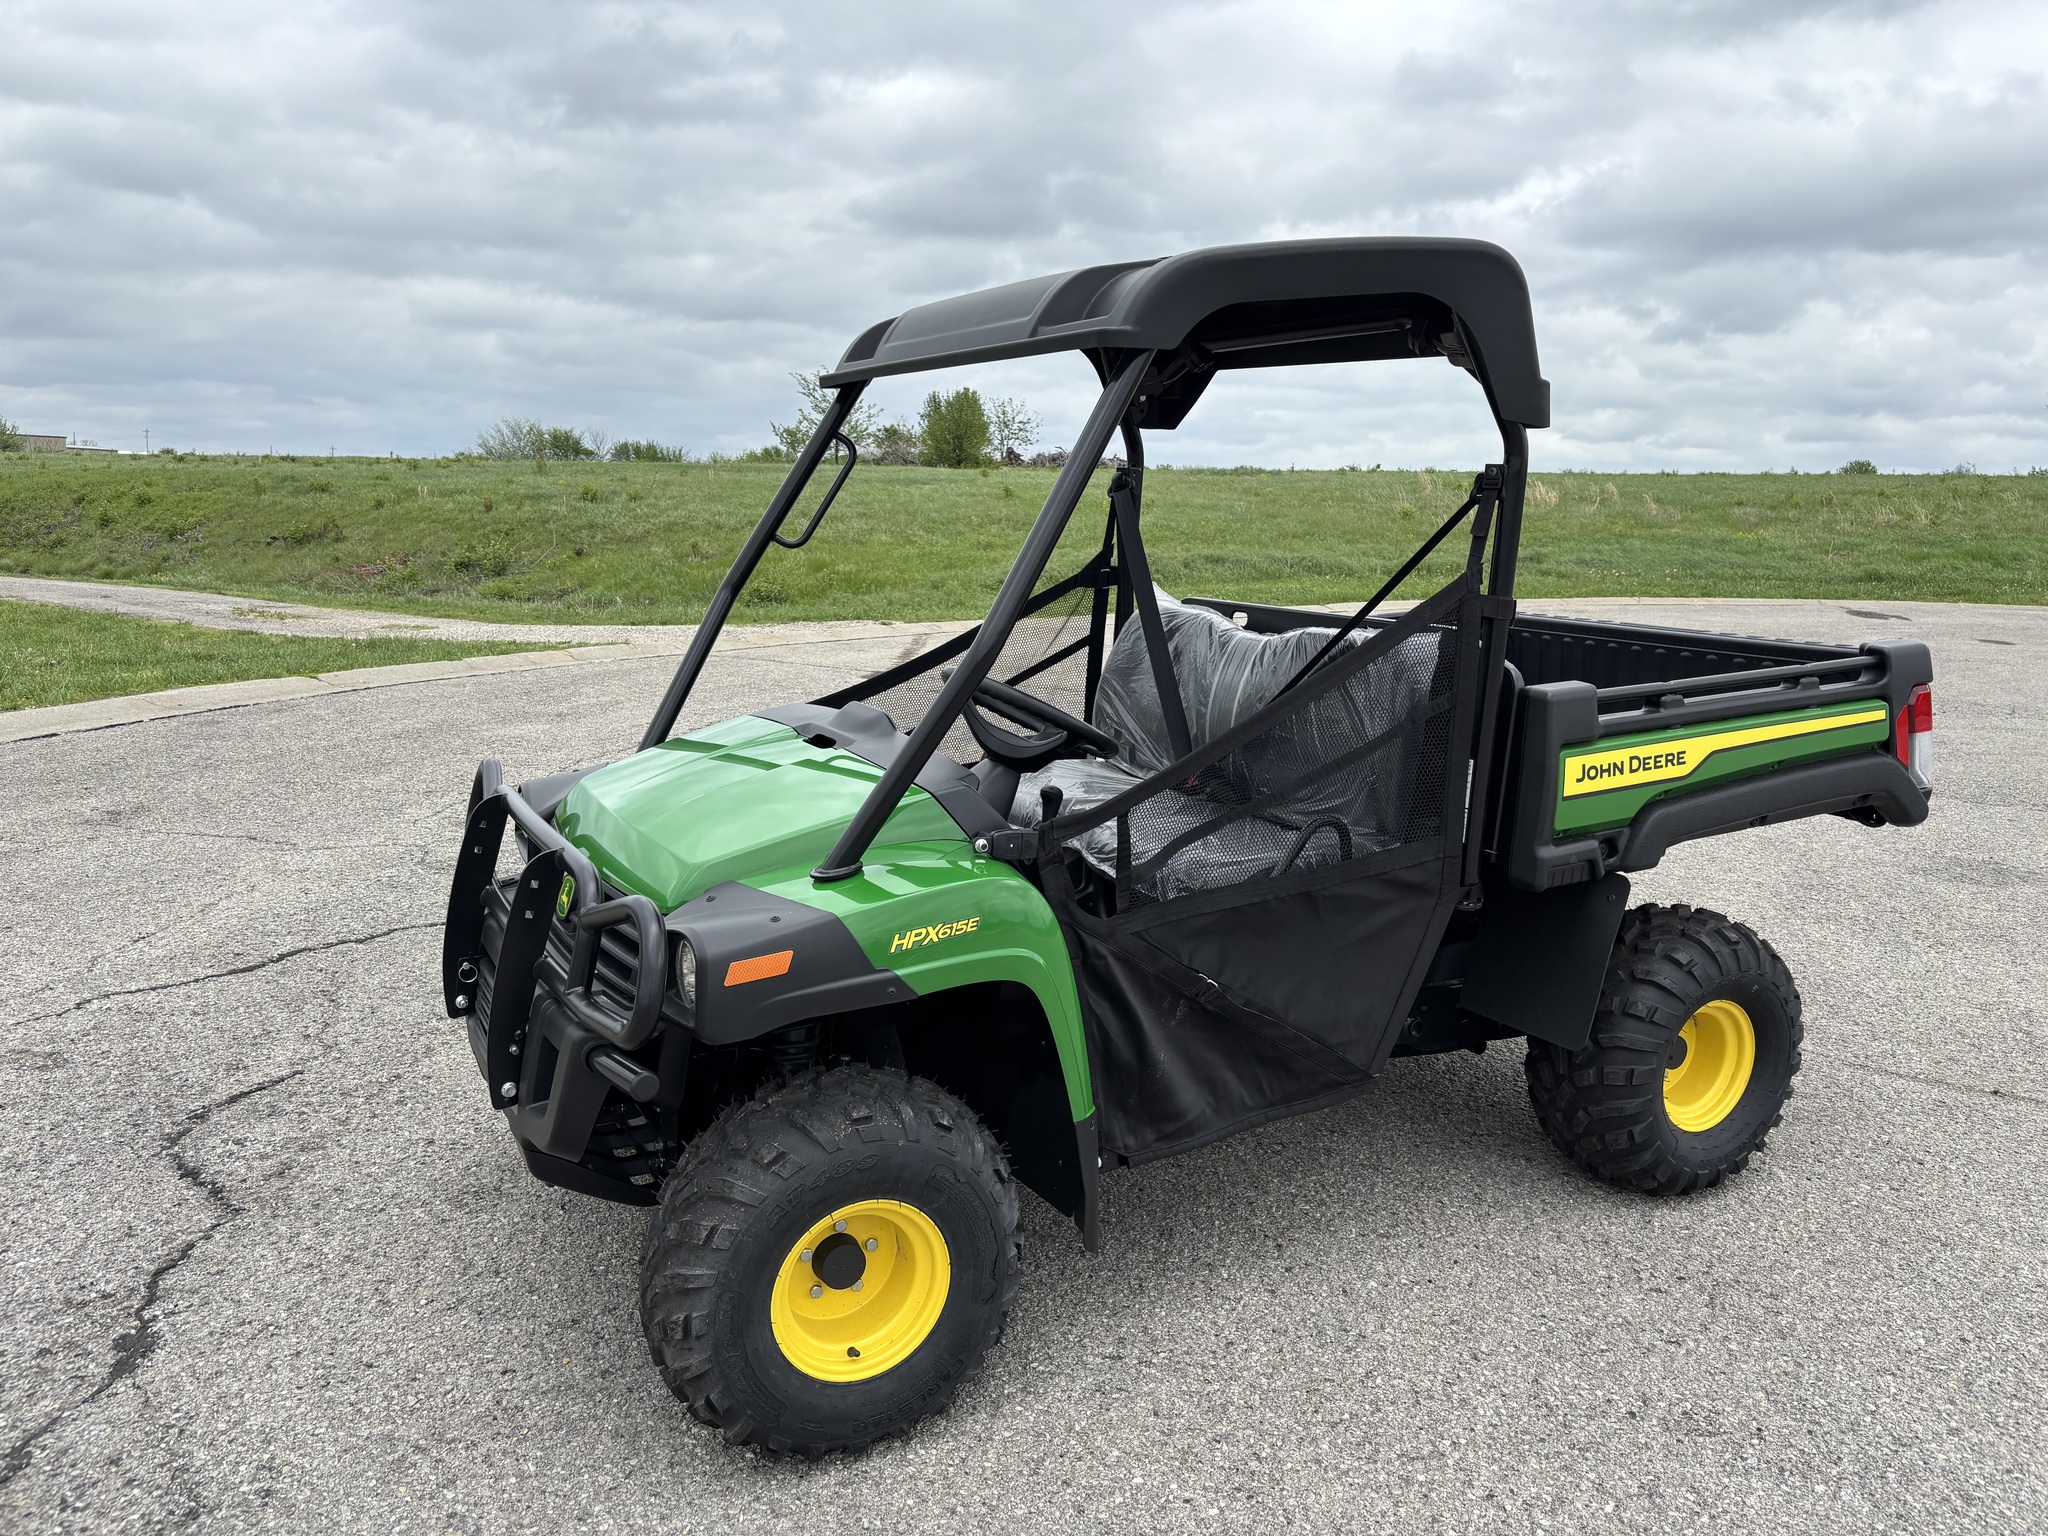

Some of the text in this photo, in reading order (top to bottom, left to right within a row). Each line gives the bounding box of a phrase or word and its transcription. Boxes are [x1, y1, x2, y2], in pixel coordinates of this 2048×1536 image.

[1576, 751, 1686, 783] JOHN DEERE
[889, 916, 981, 954] HPX615E
